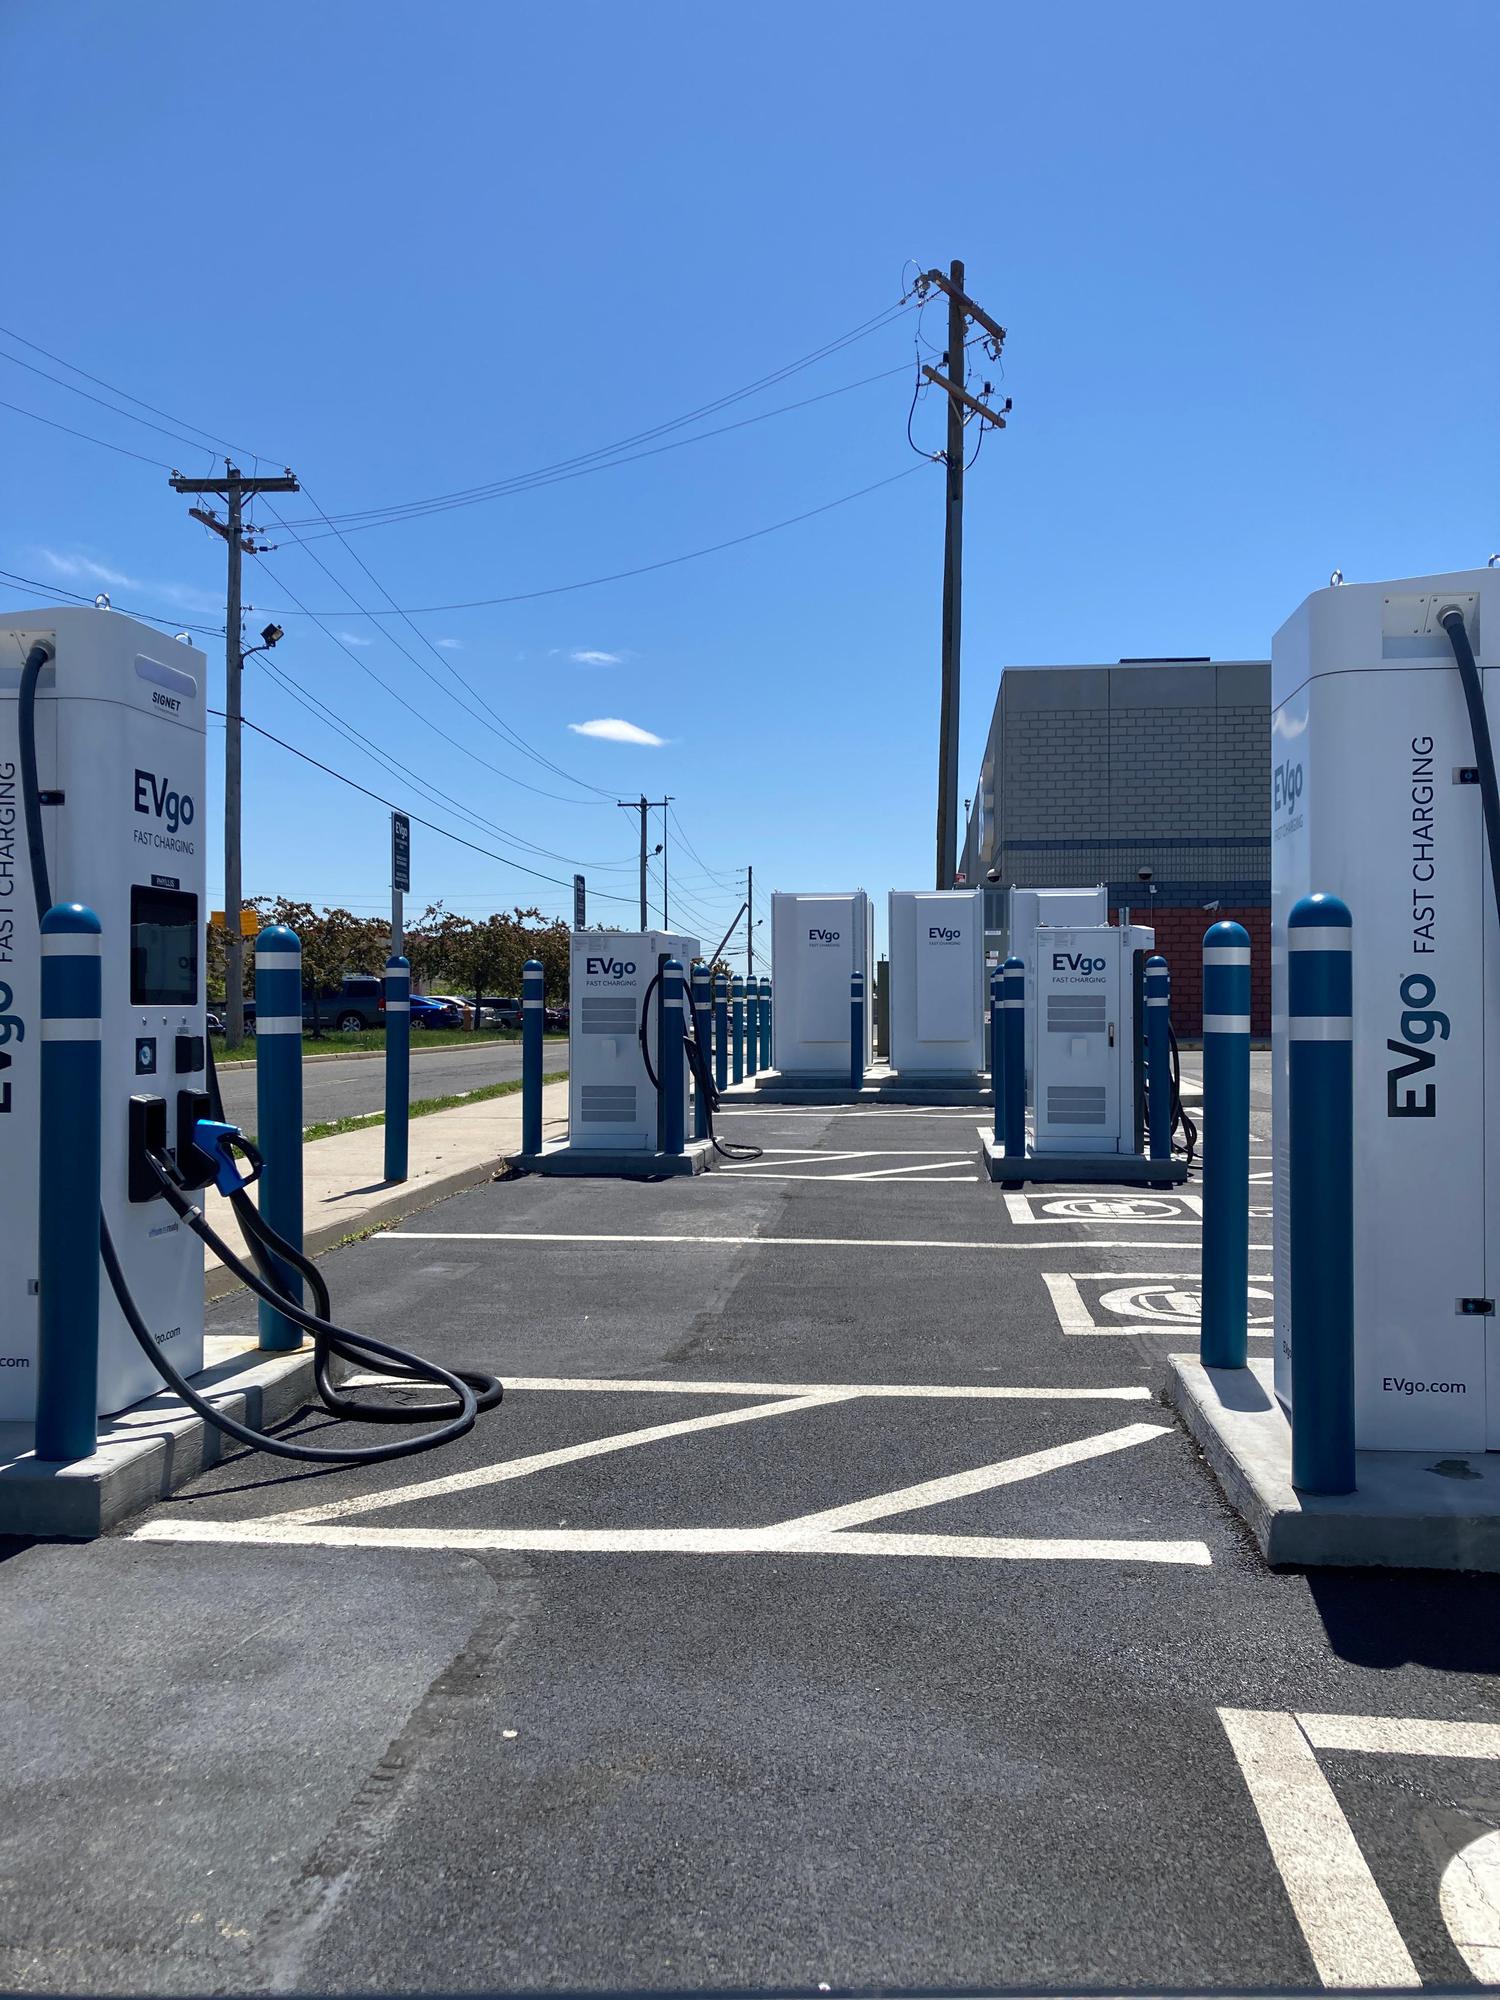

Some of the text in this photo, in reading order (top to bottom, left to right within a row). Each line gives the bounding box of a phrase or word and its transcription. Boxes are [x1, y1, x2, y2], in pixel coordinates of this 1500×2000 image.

[152, 692, 181, 711] SIGNET
[1274, 759, 1303, 815] EVgo
[134, 768, 194, 833] EVgo
[133, 829, 194, 855] FAST CHARGING
[1411, 736, 1435, 953] FAST CHARGING
[809, 929, 840, 943] EVgo
[929, 927, 961, 941] EVgo
[586, 957, 637, 979] EVgo
[1052, 953, 1106, 976] EVgo
[1387, 973, 1451, 1118] EVgo
[155, 1326, 181, 1345] go.com
[1383, 1377, 1467, 1396] EVgo.com
